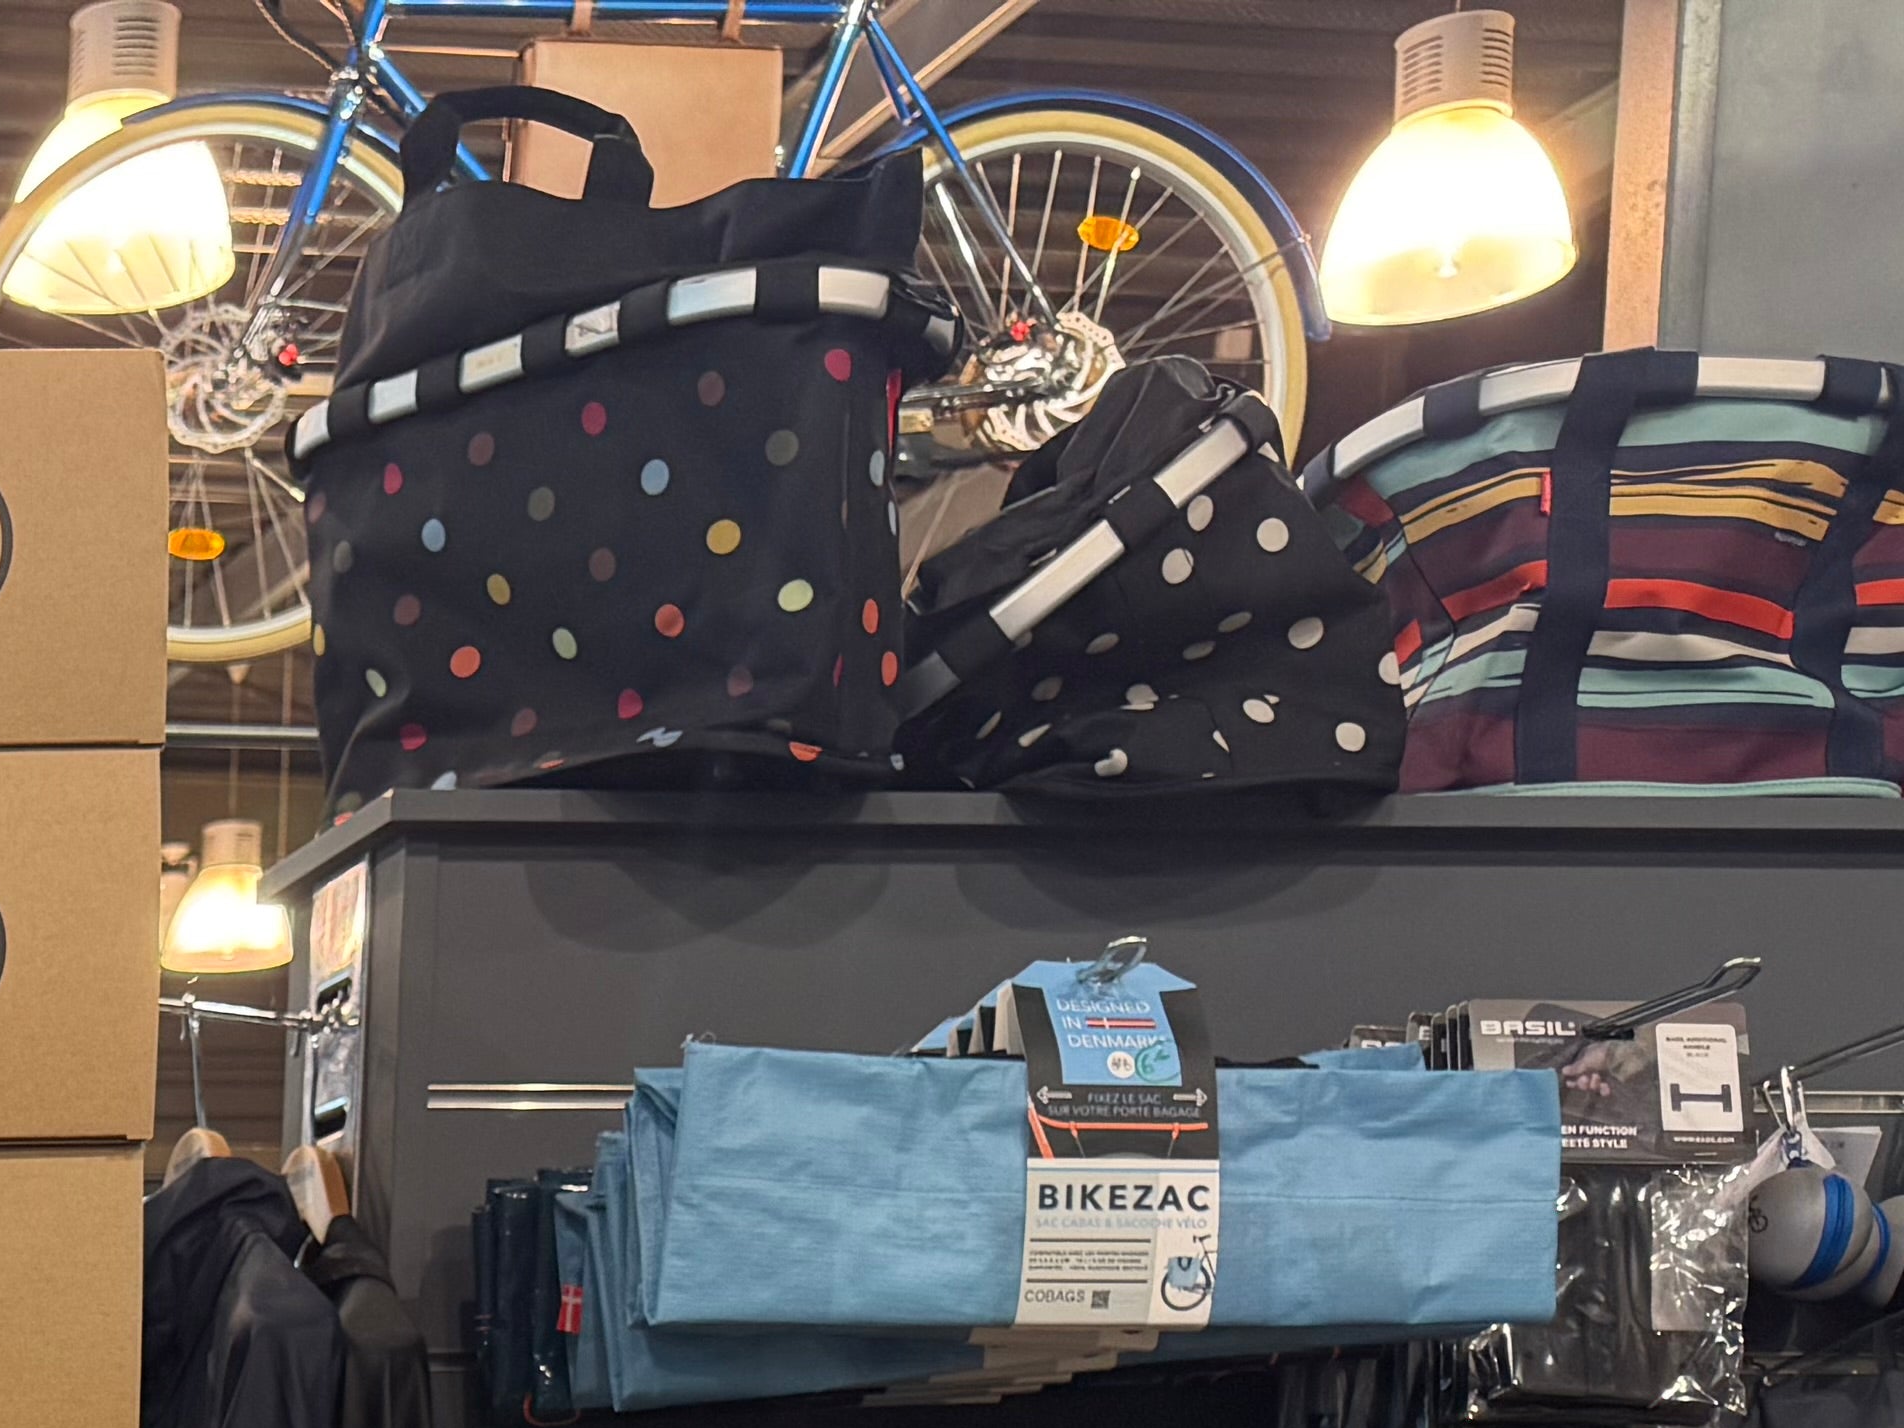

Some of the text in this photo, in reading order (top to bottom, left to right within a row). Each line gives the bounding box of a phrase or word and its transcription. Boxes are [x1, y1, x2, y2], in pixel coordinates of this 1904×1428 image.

[1056, 999, 1151, 1014] DESIGNED
[1062, 1016, 1082, 1030] IN
[1038, 1184, 1210, 1212] BIKEZAC
